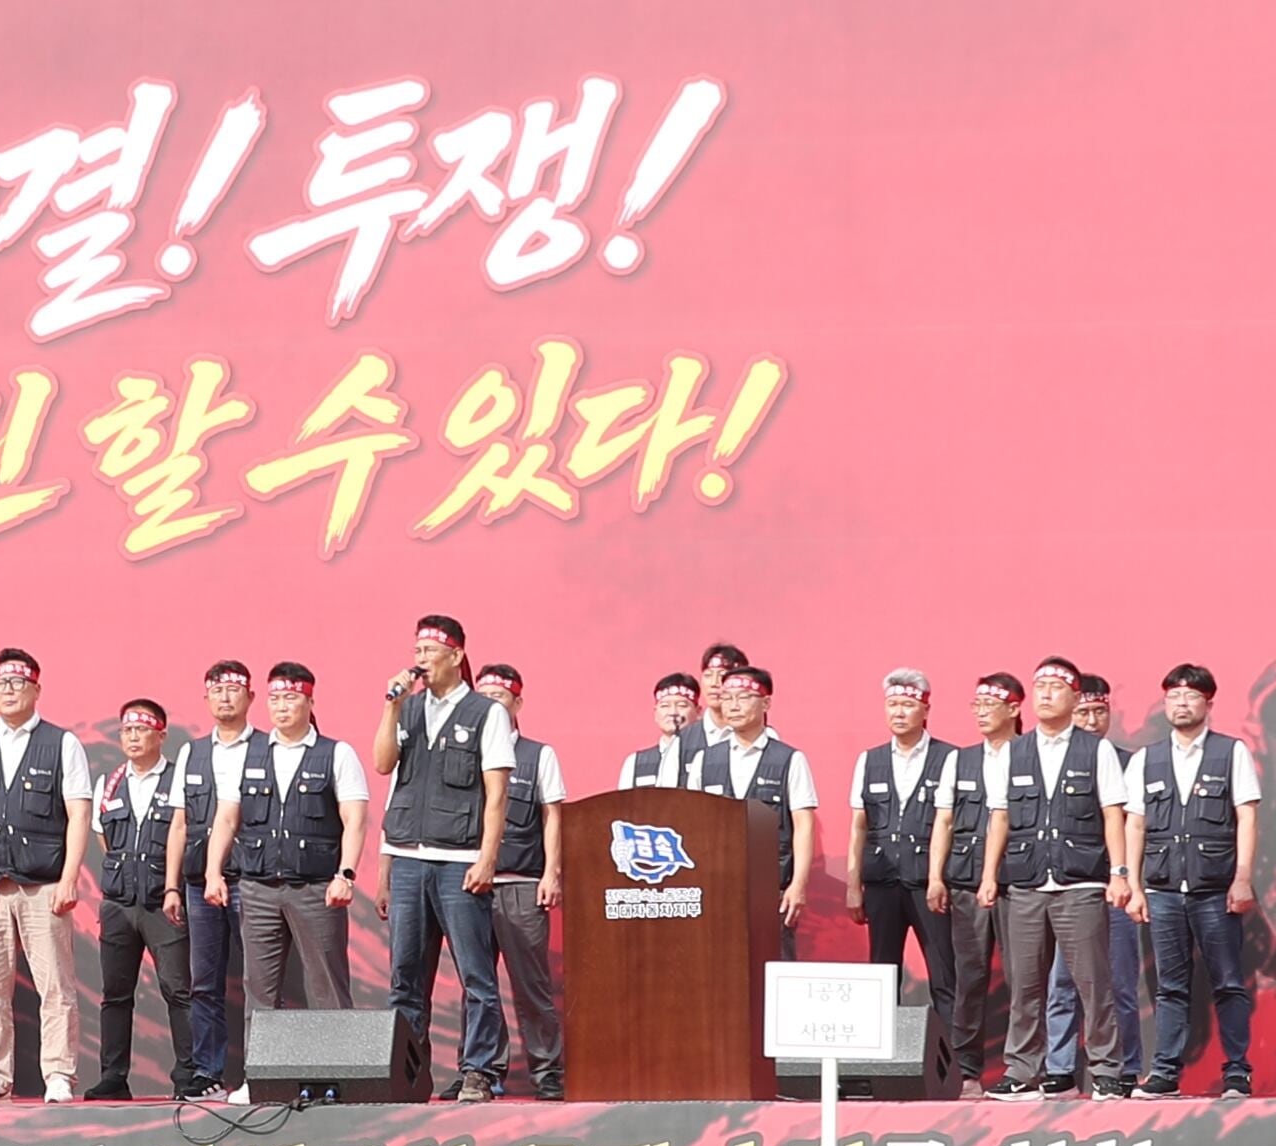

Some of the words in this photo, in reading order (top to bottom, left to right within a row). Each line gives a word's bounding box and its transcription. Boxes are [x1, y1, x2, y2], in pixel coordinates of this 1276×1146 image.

[249, 77, 723, 318] 투쟁!
[83, 358, 251, 555] 할
[245, 354, 411, 556] 수
[414, 340, 782, 532] 있다!
[800, 1022, 858, 1044] 사업부
